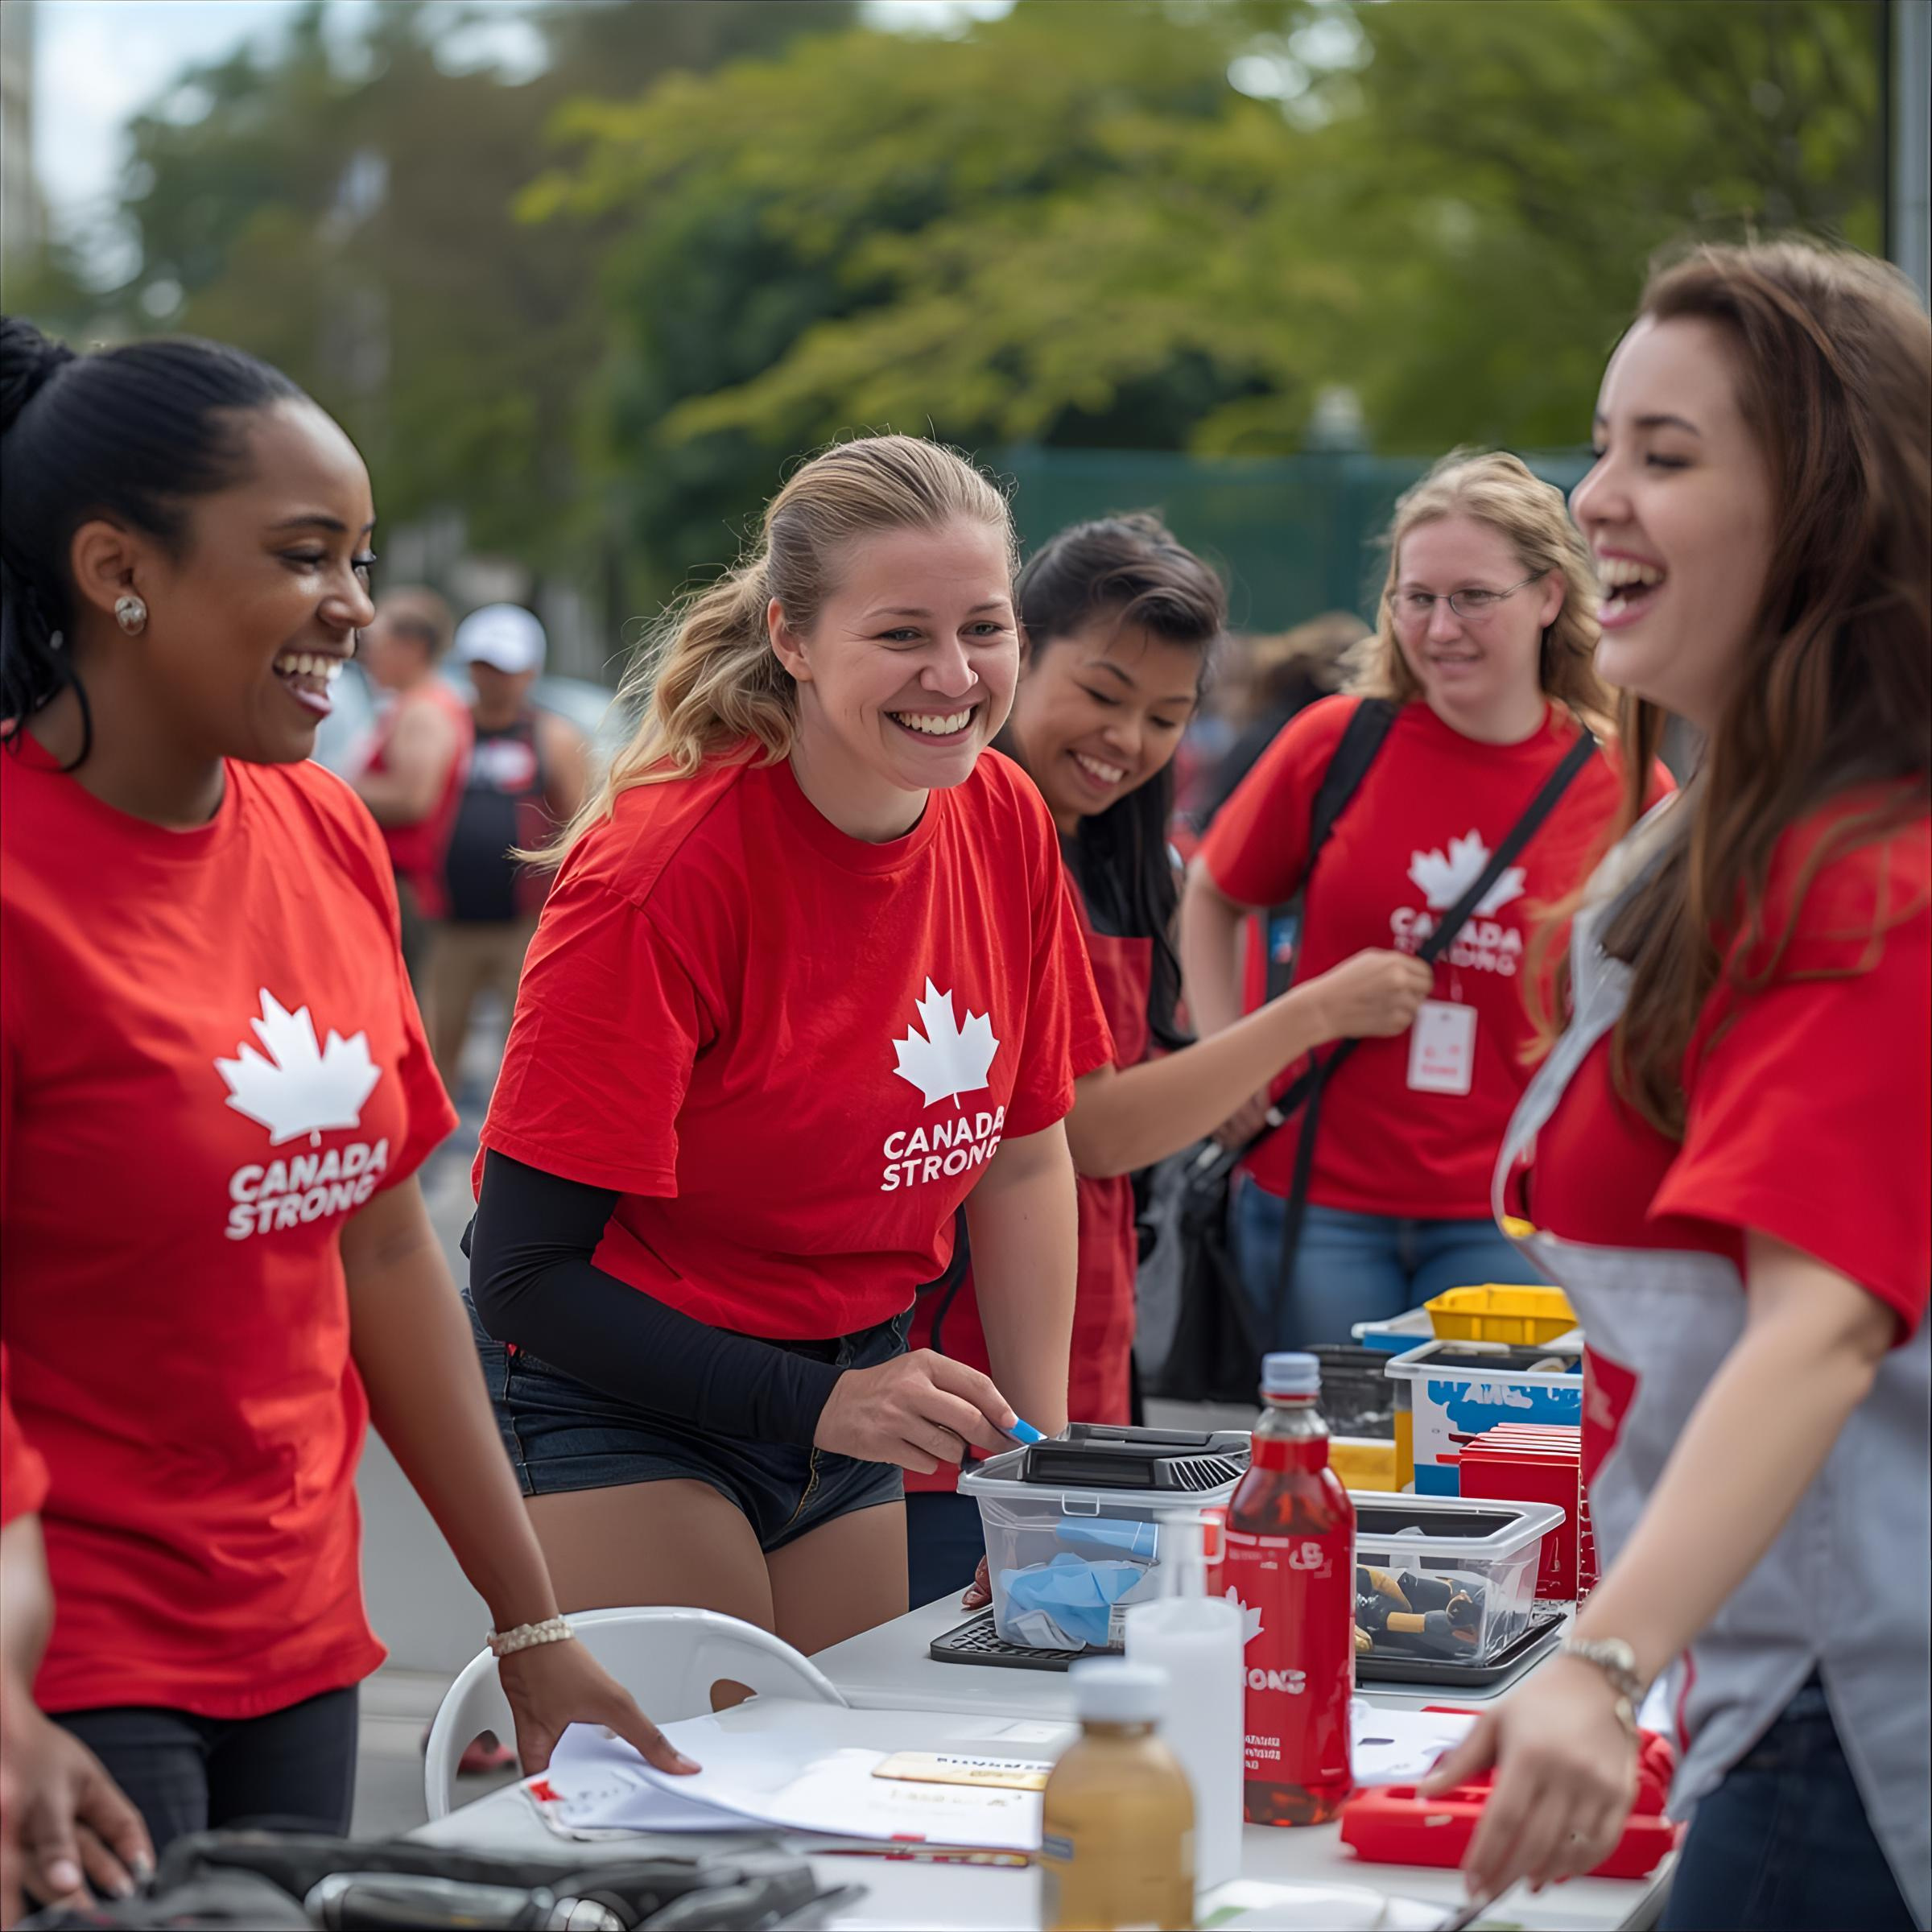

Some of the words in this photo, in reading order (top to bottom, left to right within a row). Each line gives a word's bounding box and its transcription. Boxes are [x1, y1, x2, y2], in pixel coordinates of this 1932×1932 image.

[1389, 906, 1522, 956] CAADA
[883, 1105, 1005, 1160] CANADA
[229, 1137, 389, 1203] CANADA
[881, 1135, 1001, 1191] STRONG
[225, 1173, 375, 1241] STRONG
